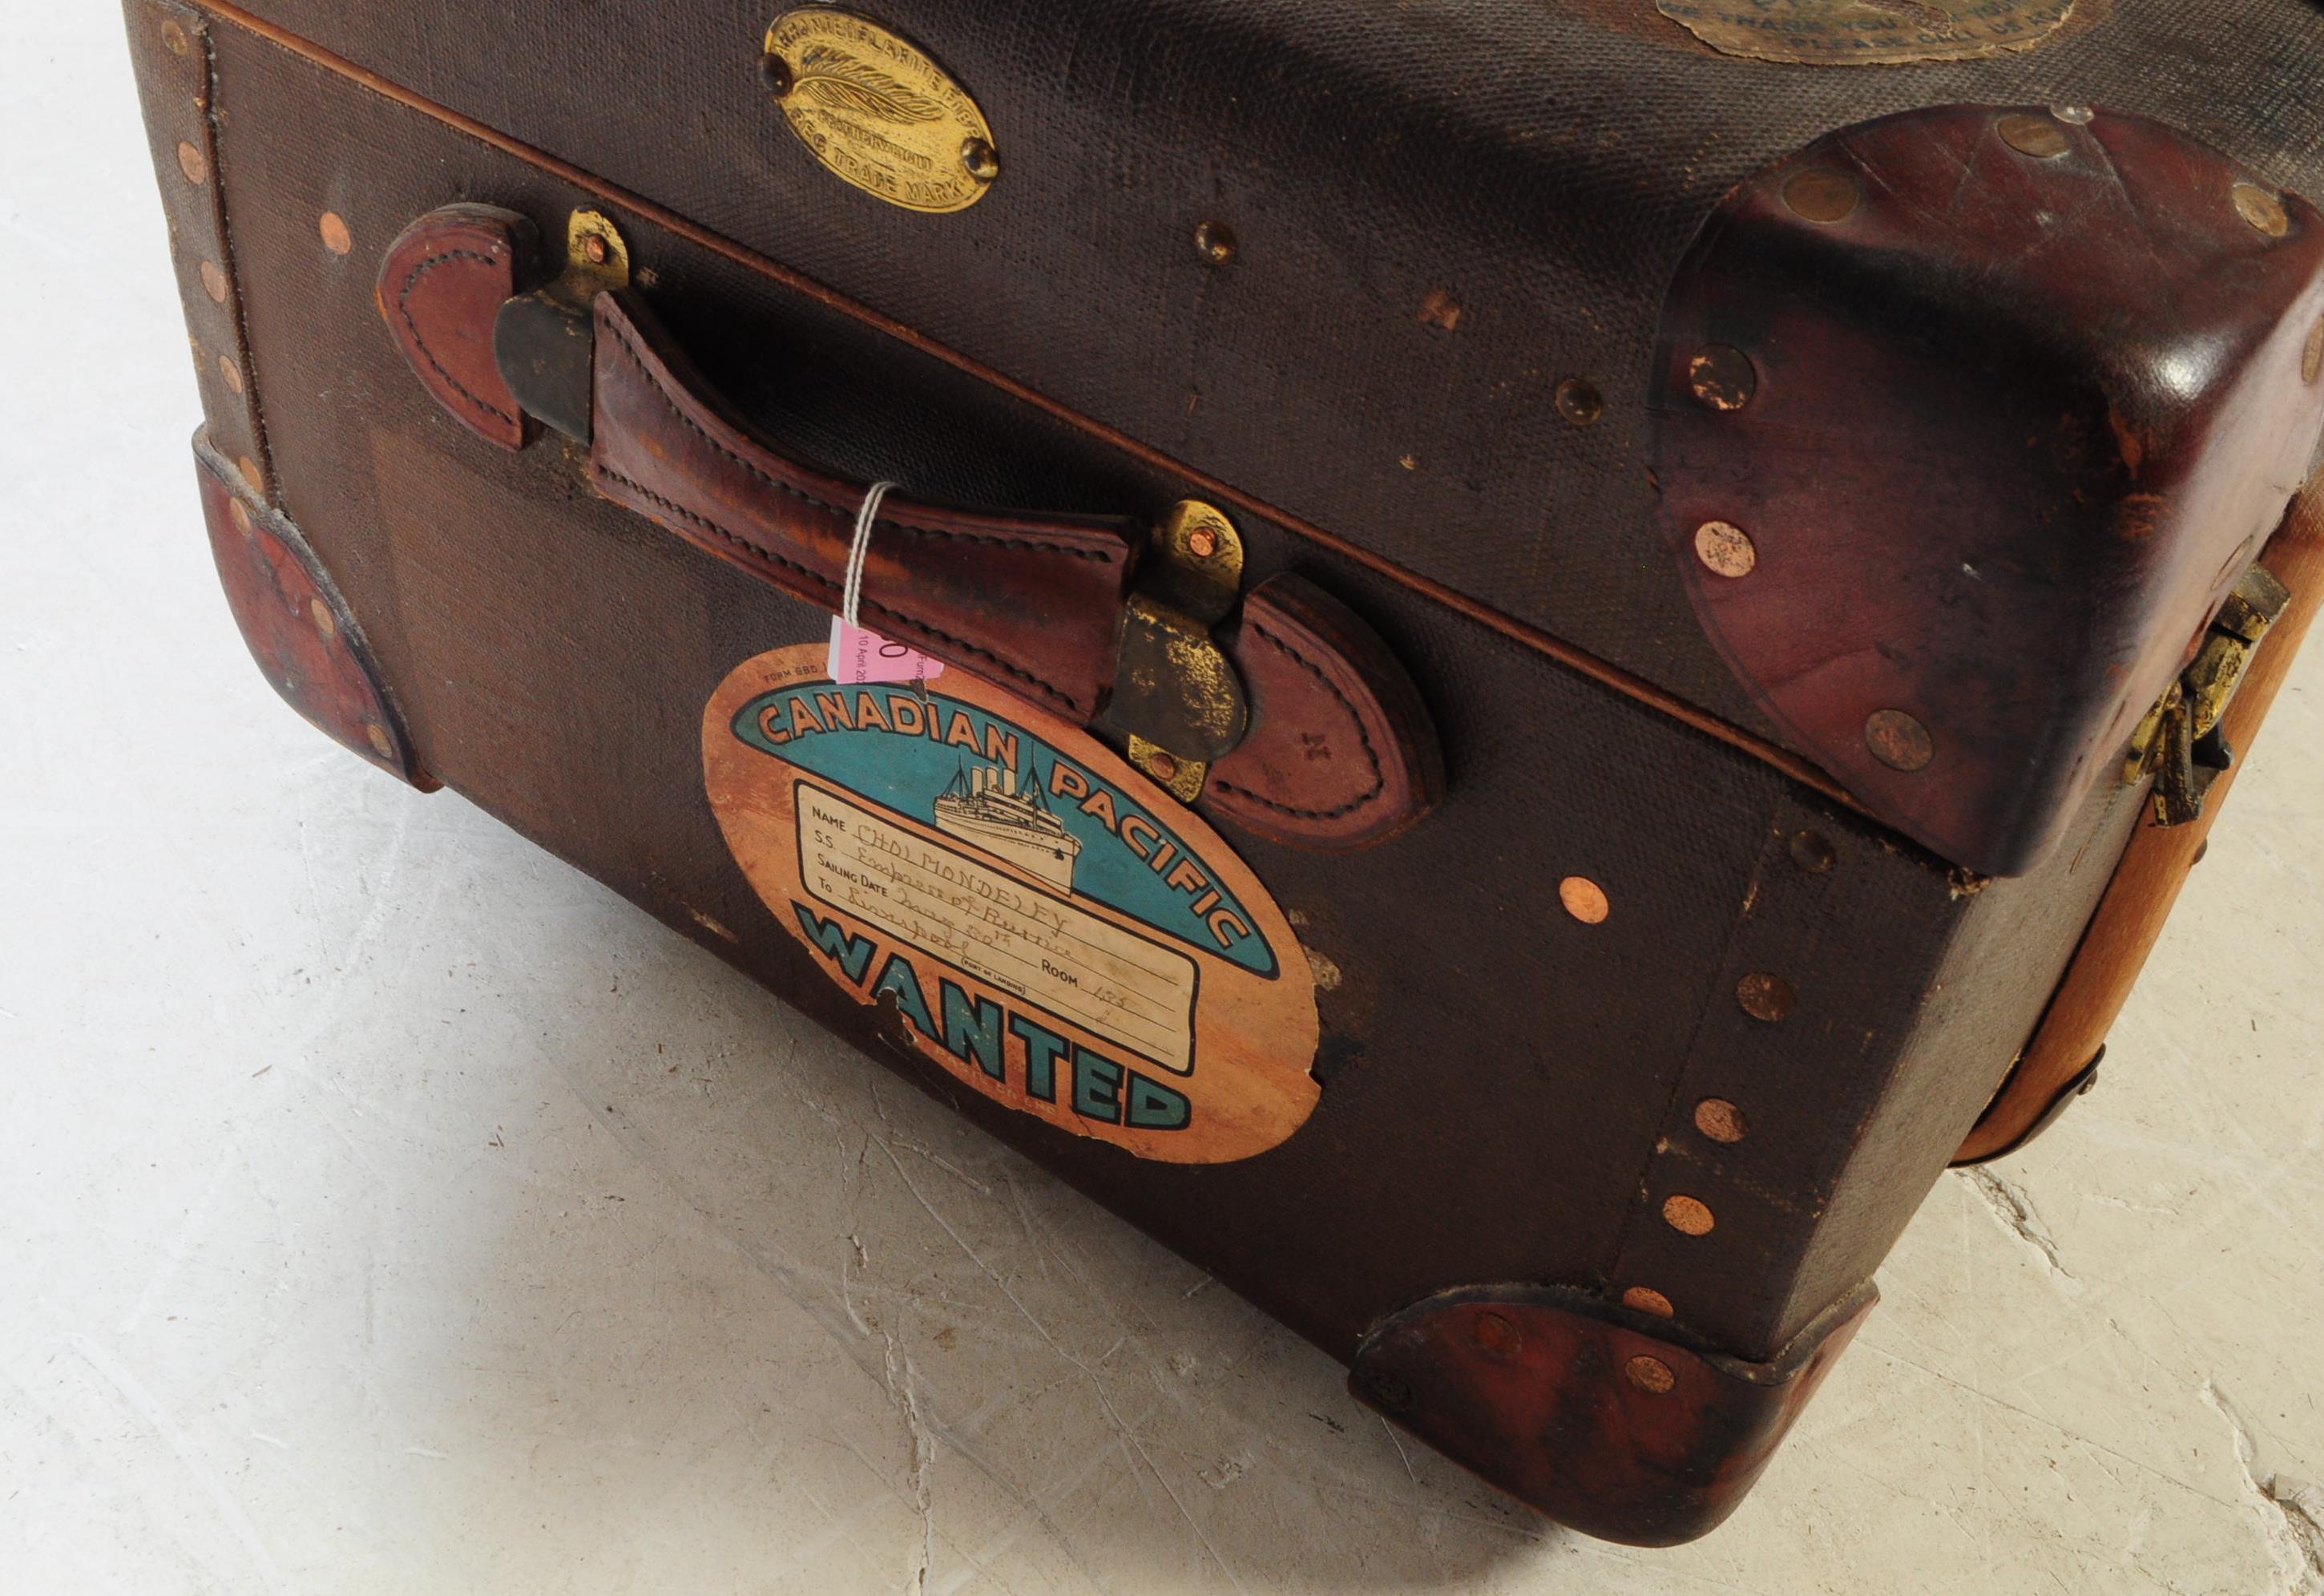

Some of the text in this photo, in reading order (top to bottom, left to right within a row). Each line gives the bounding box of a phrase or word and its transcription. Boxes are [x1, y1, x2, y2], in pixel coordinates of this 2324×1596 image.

[834, 147, 898, 193] TRADE
[905, 177, 963, 202] MARK
[854, 648, 868, 668] April
[764, 669, 792, 685] FORM
[757, 690, 1253, 950] CANADIAN PACIFIC
[812, 805, 847, 832] NAME
[814, 829, 836, 851] S.S.
[817, 852, 888, 898] SAILING DATE
[1041, 958, 1078, 988] ROOM
[790, 899, 1192, 1131] WANTED
